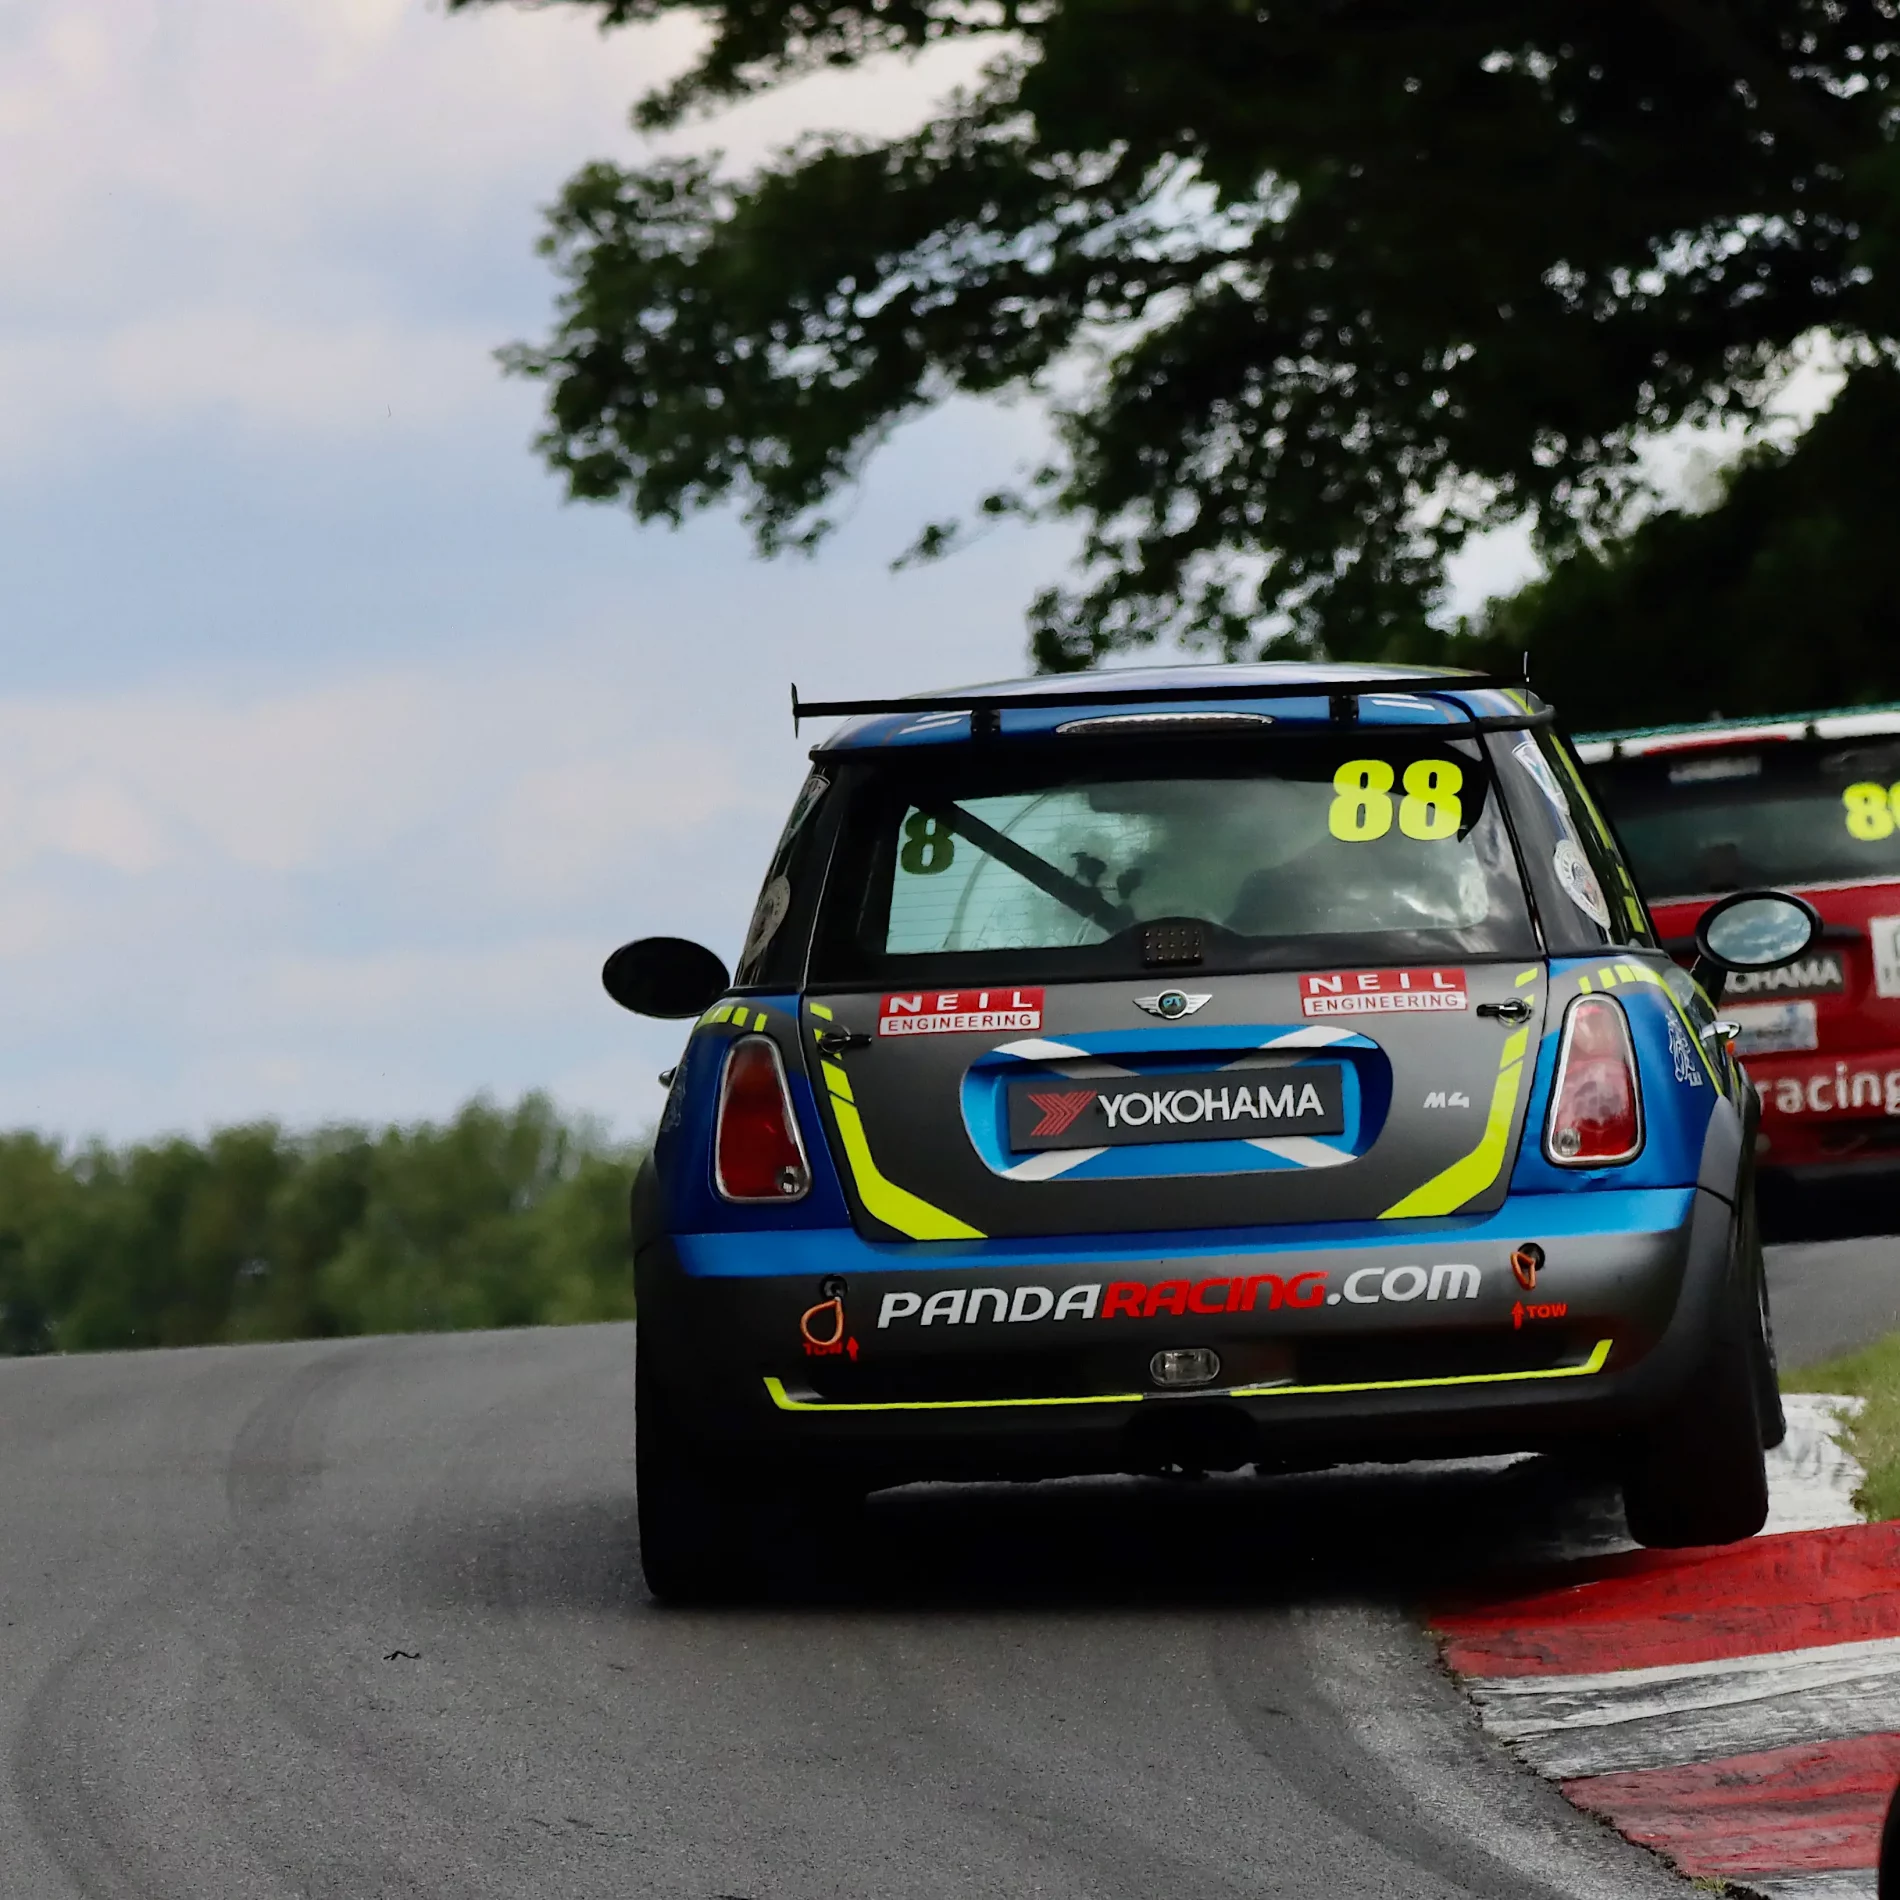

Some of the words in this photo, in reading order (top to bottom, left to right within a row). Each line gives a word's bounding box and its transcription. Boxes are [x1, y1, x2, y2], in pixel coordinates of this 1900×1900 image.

[1328, 759, 1463, 842] 88
[1308, 972, 1456, 995] NEIL
[1724, 957, 1843, 994] OHAMA
[889, 991, 1033, 1014] NEIL
[1312, 994, 1458, 1013] ENGINEERING
[888, 1014, 1032, 1032] ENGINEERING
[1098, 1083, 1325, 1128] YOKOHAMA
[1422, 1091, 1470, 1109] M4
[877, 1263, 1482, 1330] PANDARACING.COM
[1526, 1303, 1567, 1319] TOW
